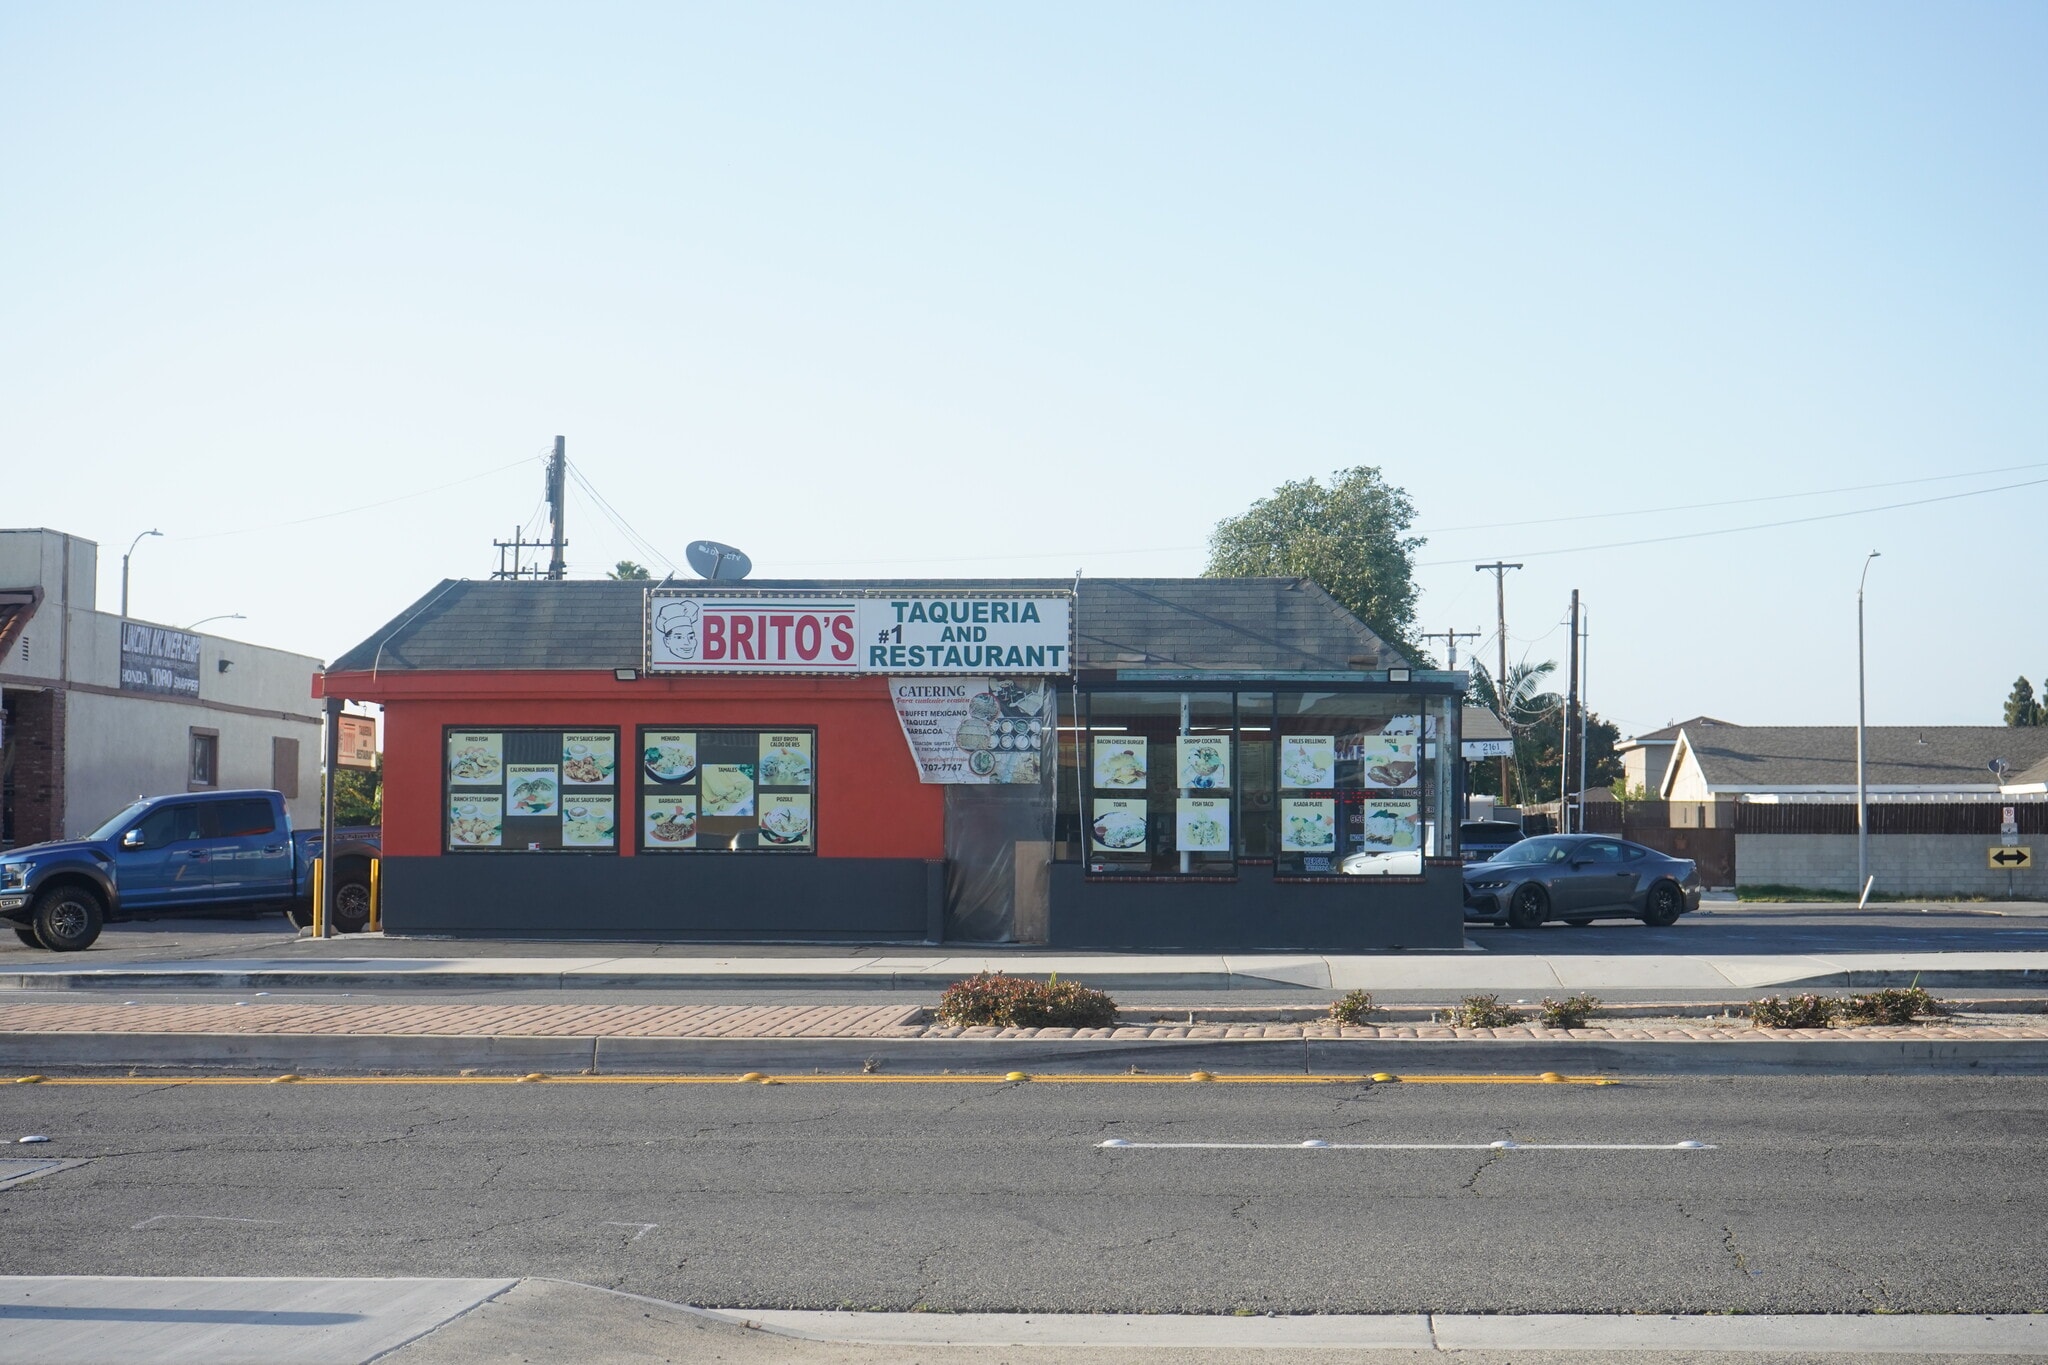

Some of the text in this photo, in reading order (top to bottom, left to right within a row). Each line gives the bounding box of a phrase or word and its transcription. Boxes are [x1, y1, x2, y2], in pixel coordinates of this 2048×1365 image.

[891, 601, 1041, 624] TAQUERIA
[702, 614, 855, 661] BRITO'S
[878, 624, 902, 644] #1
[940, 626, 987, 643] AND
[869, 645, 1065, 667] RESTAURANT
[121, 669, 148, 685] HONDA
[151, 667, 173, 688] TORO
[898, 685, 966, 697] CATERING
[1482, 742, 1500, 751] 2161
